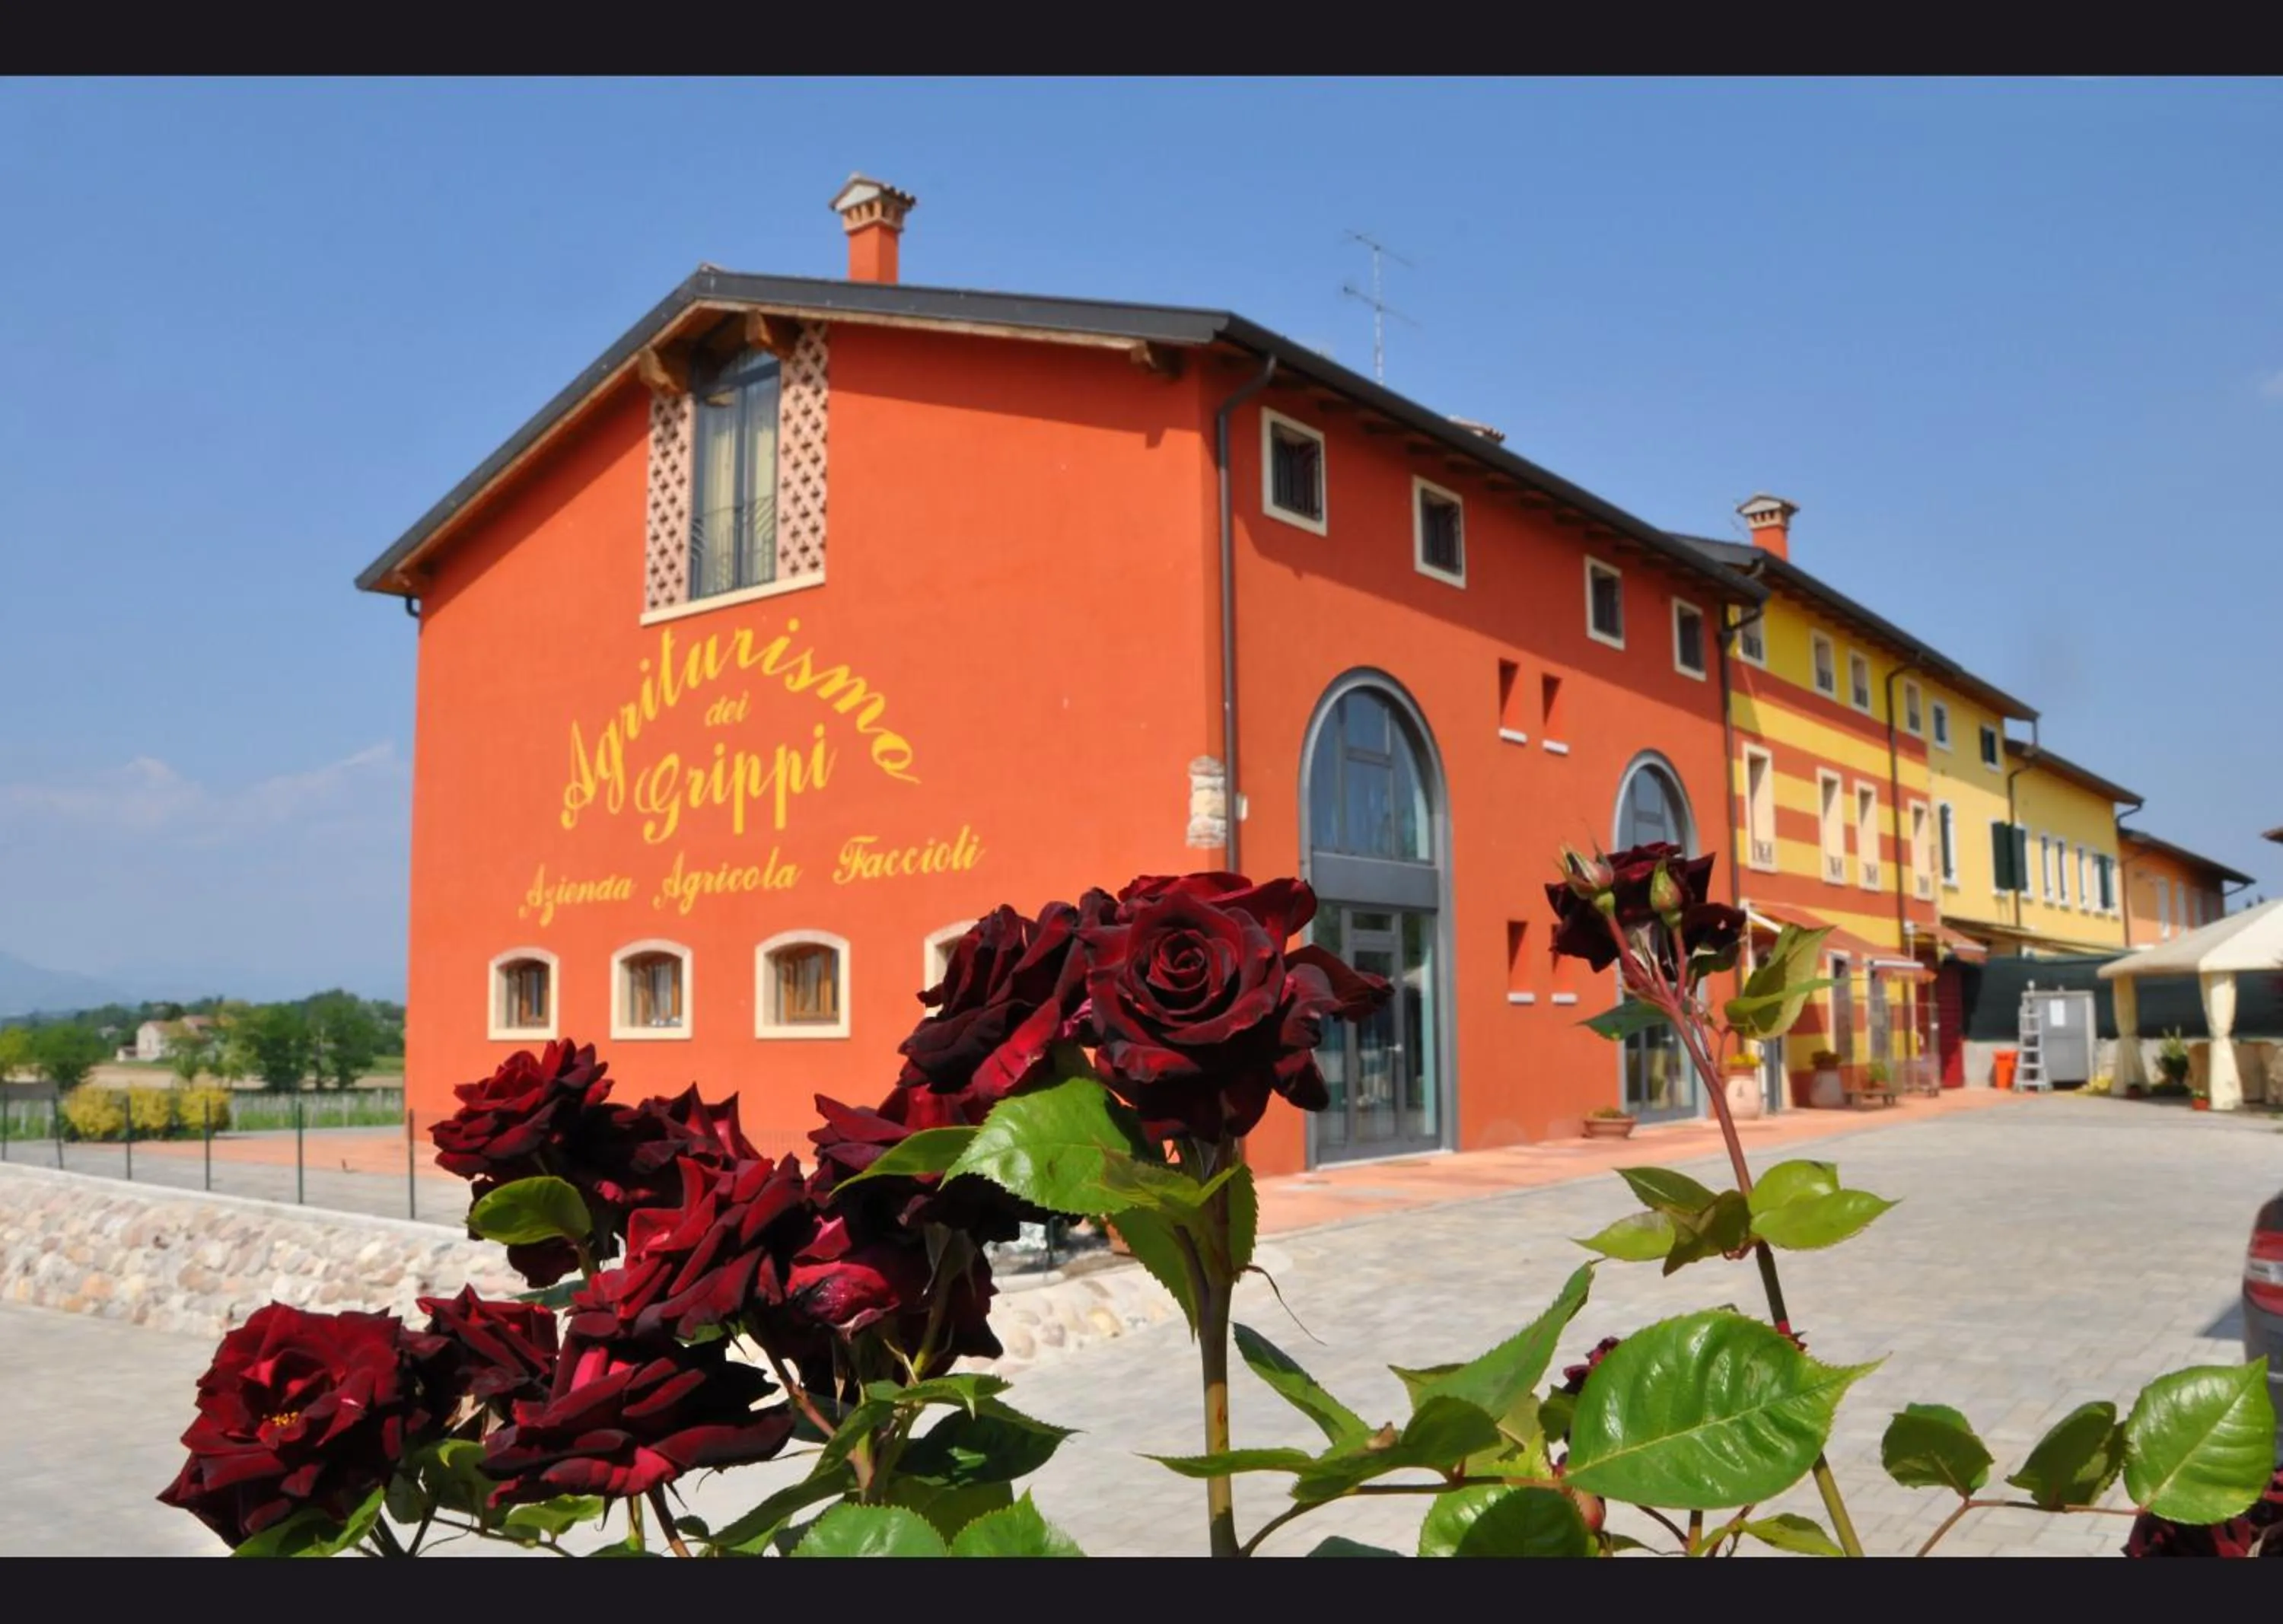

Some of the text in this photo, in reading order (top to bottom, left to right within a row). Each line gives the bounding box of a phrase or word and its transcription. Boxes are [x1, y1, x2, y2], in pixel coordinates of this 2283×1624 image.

[561, 618, 921, 830] Agriturismo
[705, 690, 749, 727] dei
[635, 724, 836, 844] Grippi
[518, 825, 985, 928] Azienda Agricola Faccioli
